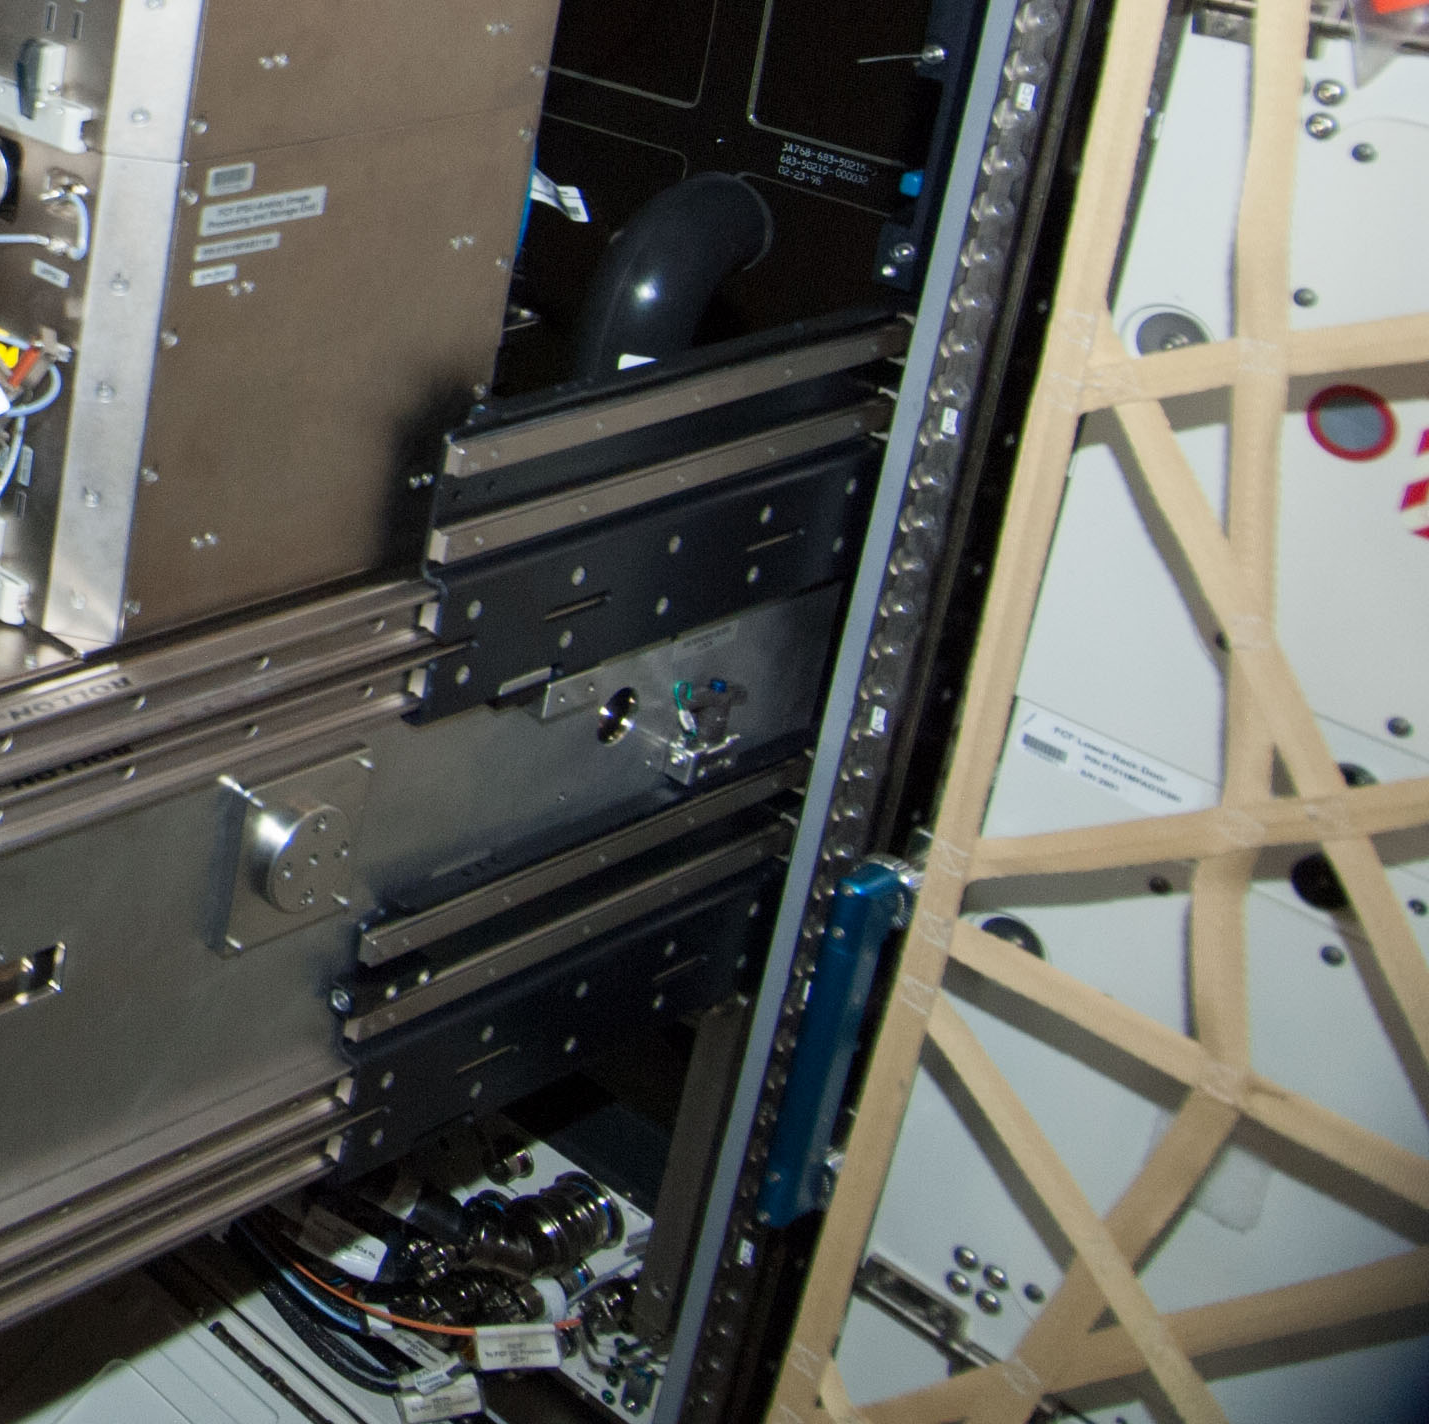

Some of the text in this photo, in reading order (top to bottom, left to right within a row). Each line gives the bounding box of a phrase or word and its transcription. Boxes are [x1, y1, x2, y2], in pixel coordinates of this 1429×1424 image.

[9, 676, 132, 721] ROLLON
[1053, 726, 1168, 783] FCF Lower Rack Door
